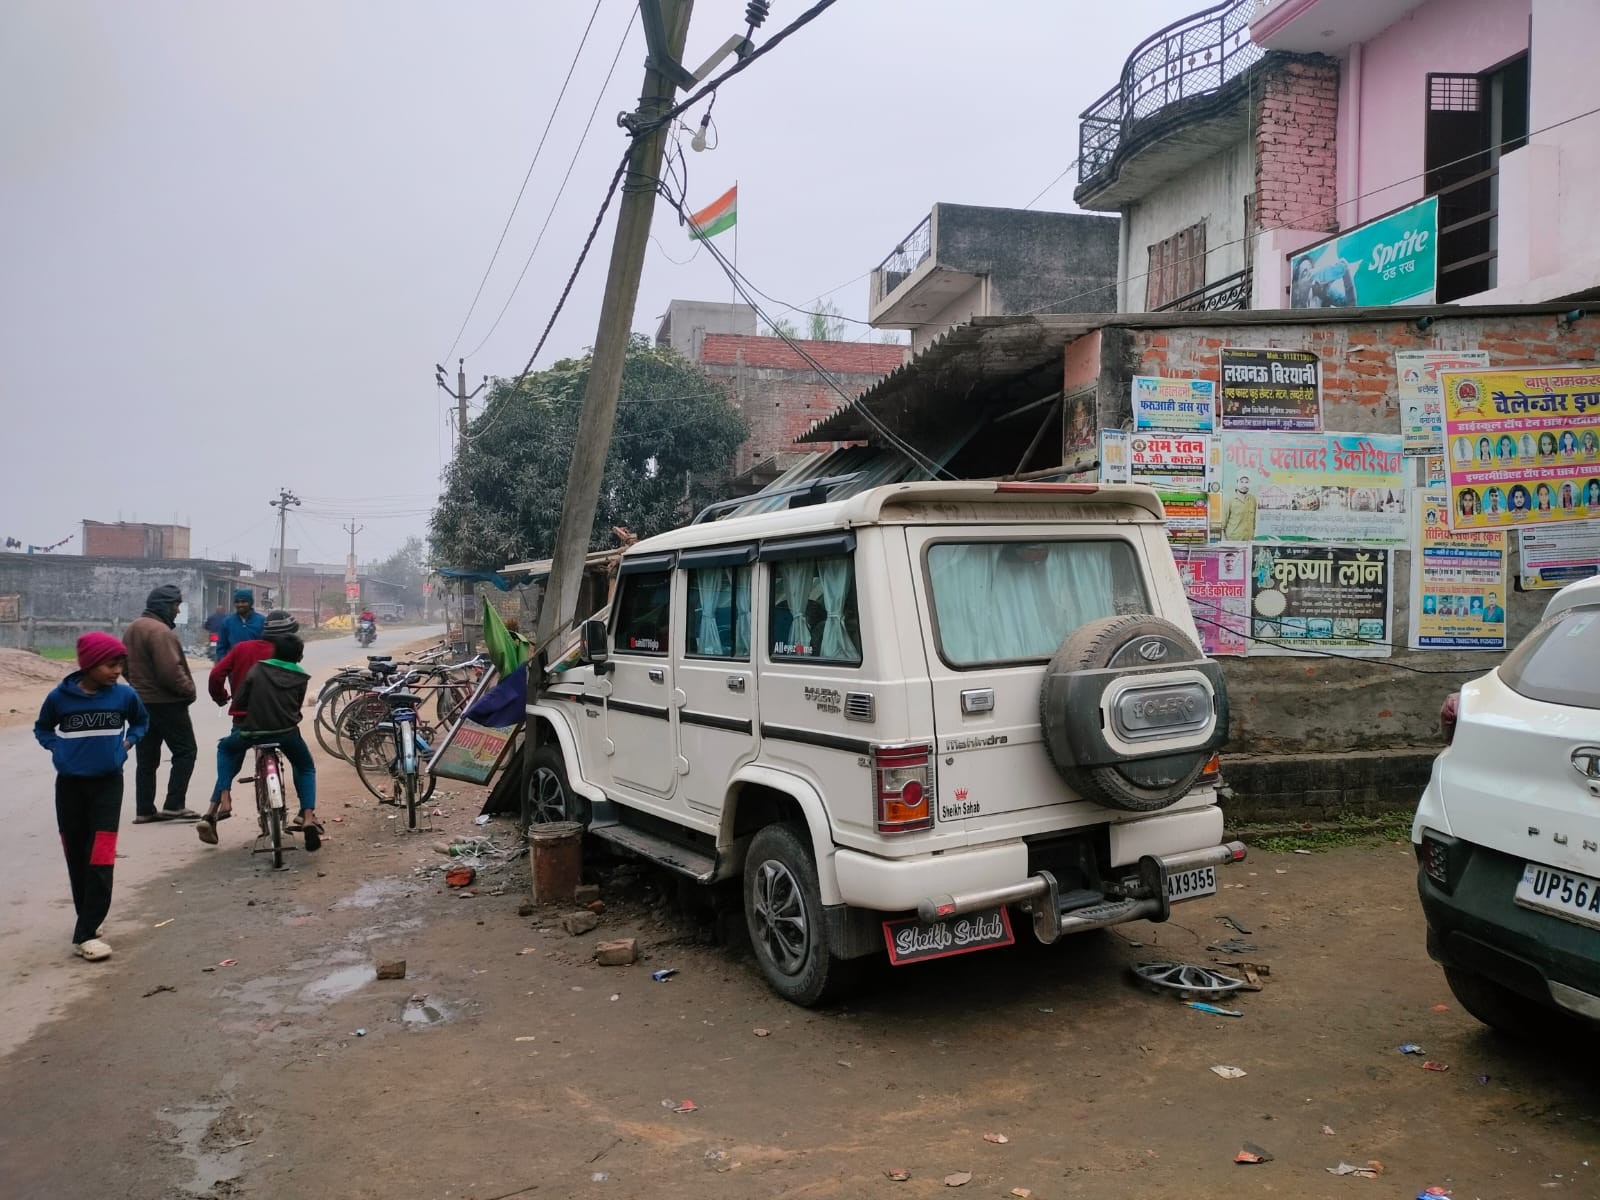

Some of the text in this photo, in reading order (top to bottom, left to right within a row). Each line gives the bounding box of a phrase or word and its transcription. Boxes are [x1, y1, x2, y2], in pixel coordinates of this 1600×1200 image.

[1368, 229, 1429, 273] Sprite
[1399, 260, 1416, 275] रख
[1223, 362, 1316, 385] लखनऊ बिरयानी
[1491, 390, 1569, 414] चैलेन्जर
[1147, 440, 1204, 454] राम रतन
[1332, 440, 1403, 474] डेकोरेशन
[1170, 455, 1204, 465] कालेज
[1273, 552, 1385, 594] कृष्णा लॉन
[1206, 581, 1245, 598] डेकोरेशन
[946, 734, 1008, 751] Mahindra
[942, 801, 981, 818] Sheikh Sahab
[1168, 868, 1214, 897] AX9355
[1533, 869, 1600, 914] UP56A
[896, 914, 1003, 954] Sheikh Sahab
